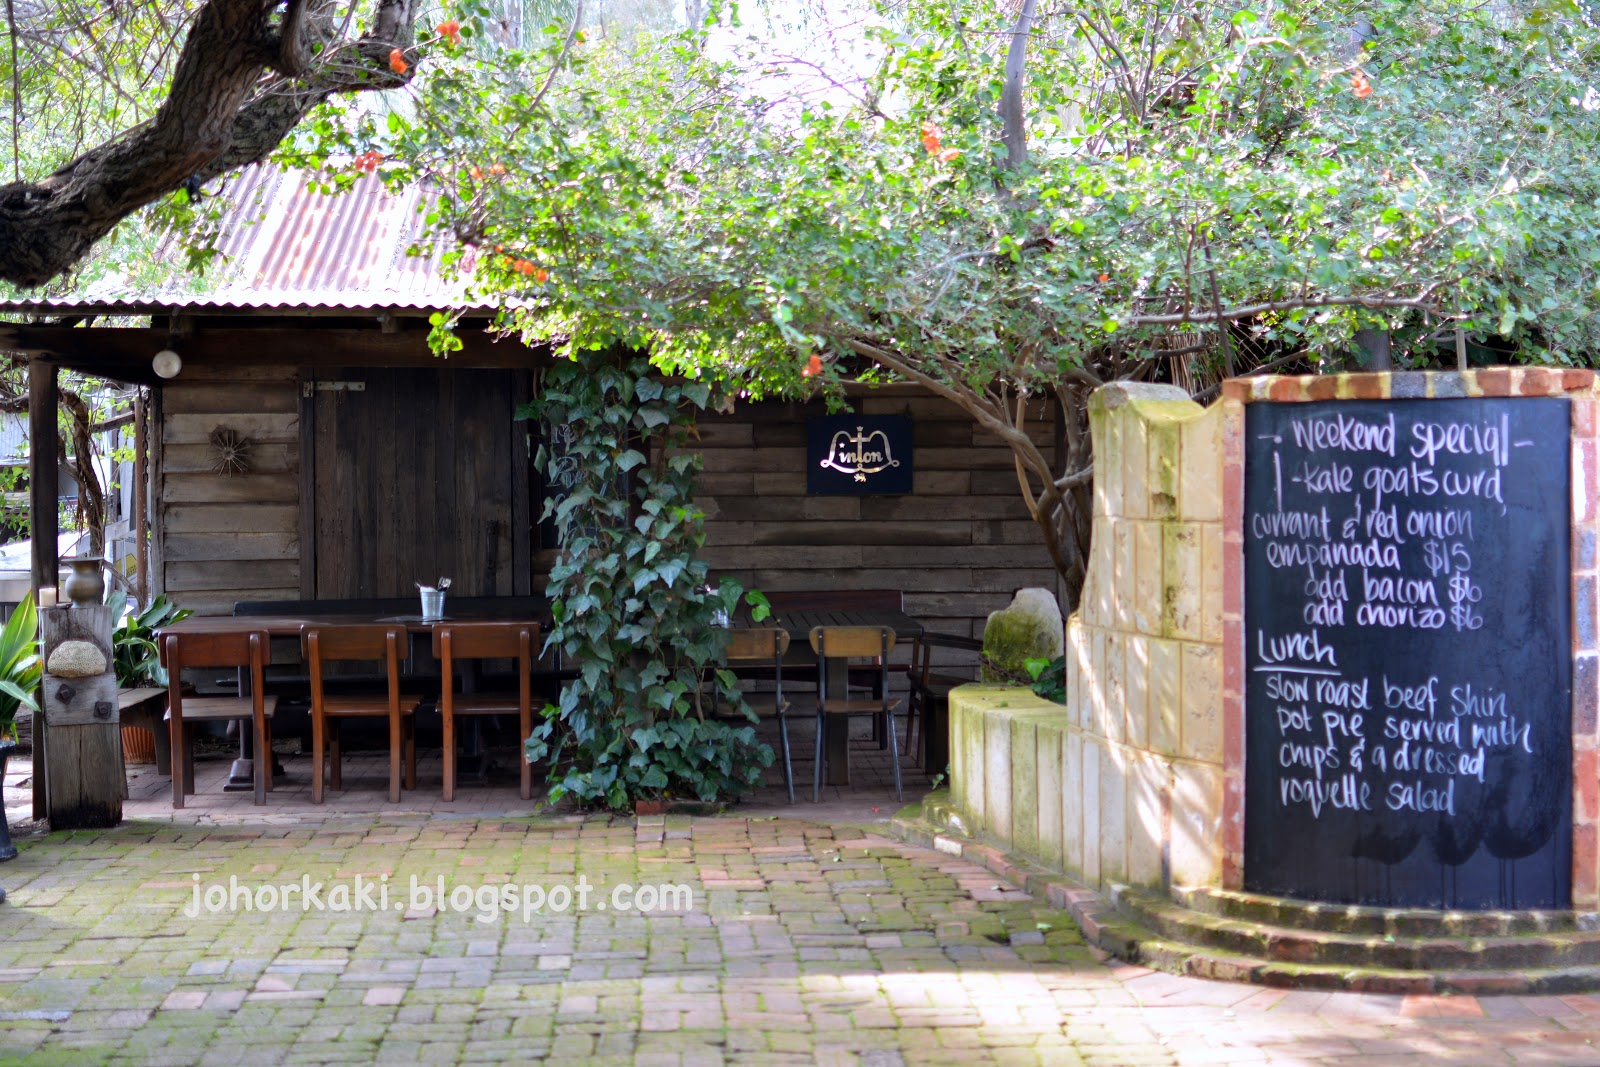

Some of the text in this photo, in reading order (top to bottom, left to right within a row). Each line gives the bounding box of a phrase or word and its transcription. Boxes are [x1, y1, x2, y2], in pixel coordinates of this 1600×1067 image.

[1364, 461, 1439, 515] goats
[1253, 494, 1474, 544] currant & red onion
[1266, 538, 1472, 579] empanada $15
[1304, 568, 1482, 606] add bacon $6
[1304, 599, 1483, 632] add chorizo $6
[1258, 629, 1338, 667] Lunch
[1316, 678, 1373, 710] roast
[1383, 674, 1438, 719] beef
[1322, 711, 1364, 750] pie
[1384, 715, 1461, 749] served
[1472, 716, 1533, 754] with
[1279, 741, 1340, 781] chips
[1350, 736, 1366, 773] &
[1385, 777, 1457, 817] salad
